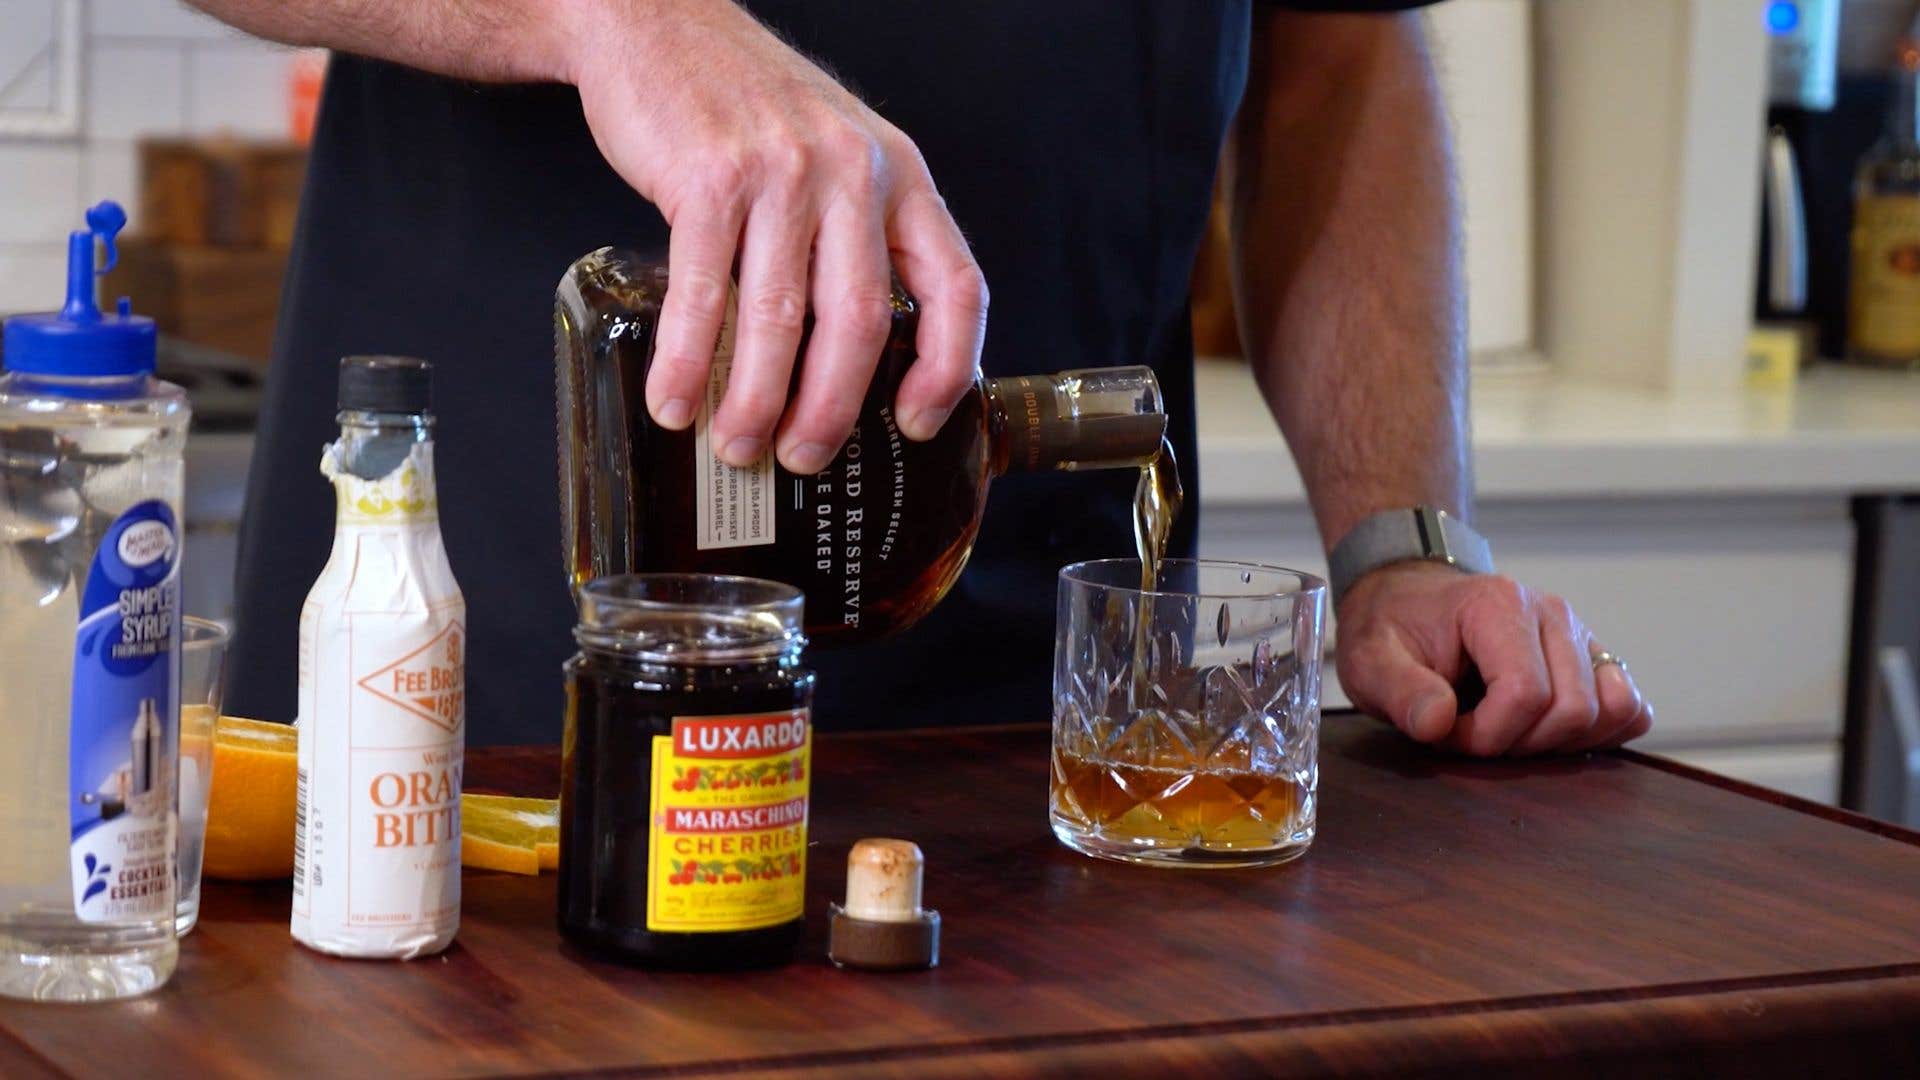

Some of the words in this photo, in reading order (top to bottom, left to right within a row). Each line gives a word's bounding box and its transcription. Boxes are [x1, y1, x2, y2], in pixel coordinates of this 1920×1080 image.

[880, 407, 902, 458] BARREL
[728, 464, 738, 502] OURBON
[894, 461, 904, 508] FINISH
[715, 497, 724, 531] BARREL
[728, 503, 738, 540] WHISKEY
[879, 512, 901, 561] SELECT
[119, 587, 175, 616] SIMPLE
[122, 613, 173, 643] SYRUP
[393, 669, 427, 693] FEE
[430, 666, 464, 692] BRO
[682, 719, 805, 751] LUXARDO
[675, 800, 802, 830] MARASCHINO
[674, 827, 801, 855] CHERRIES
